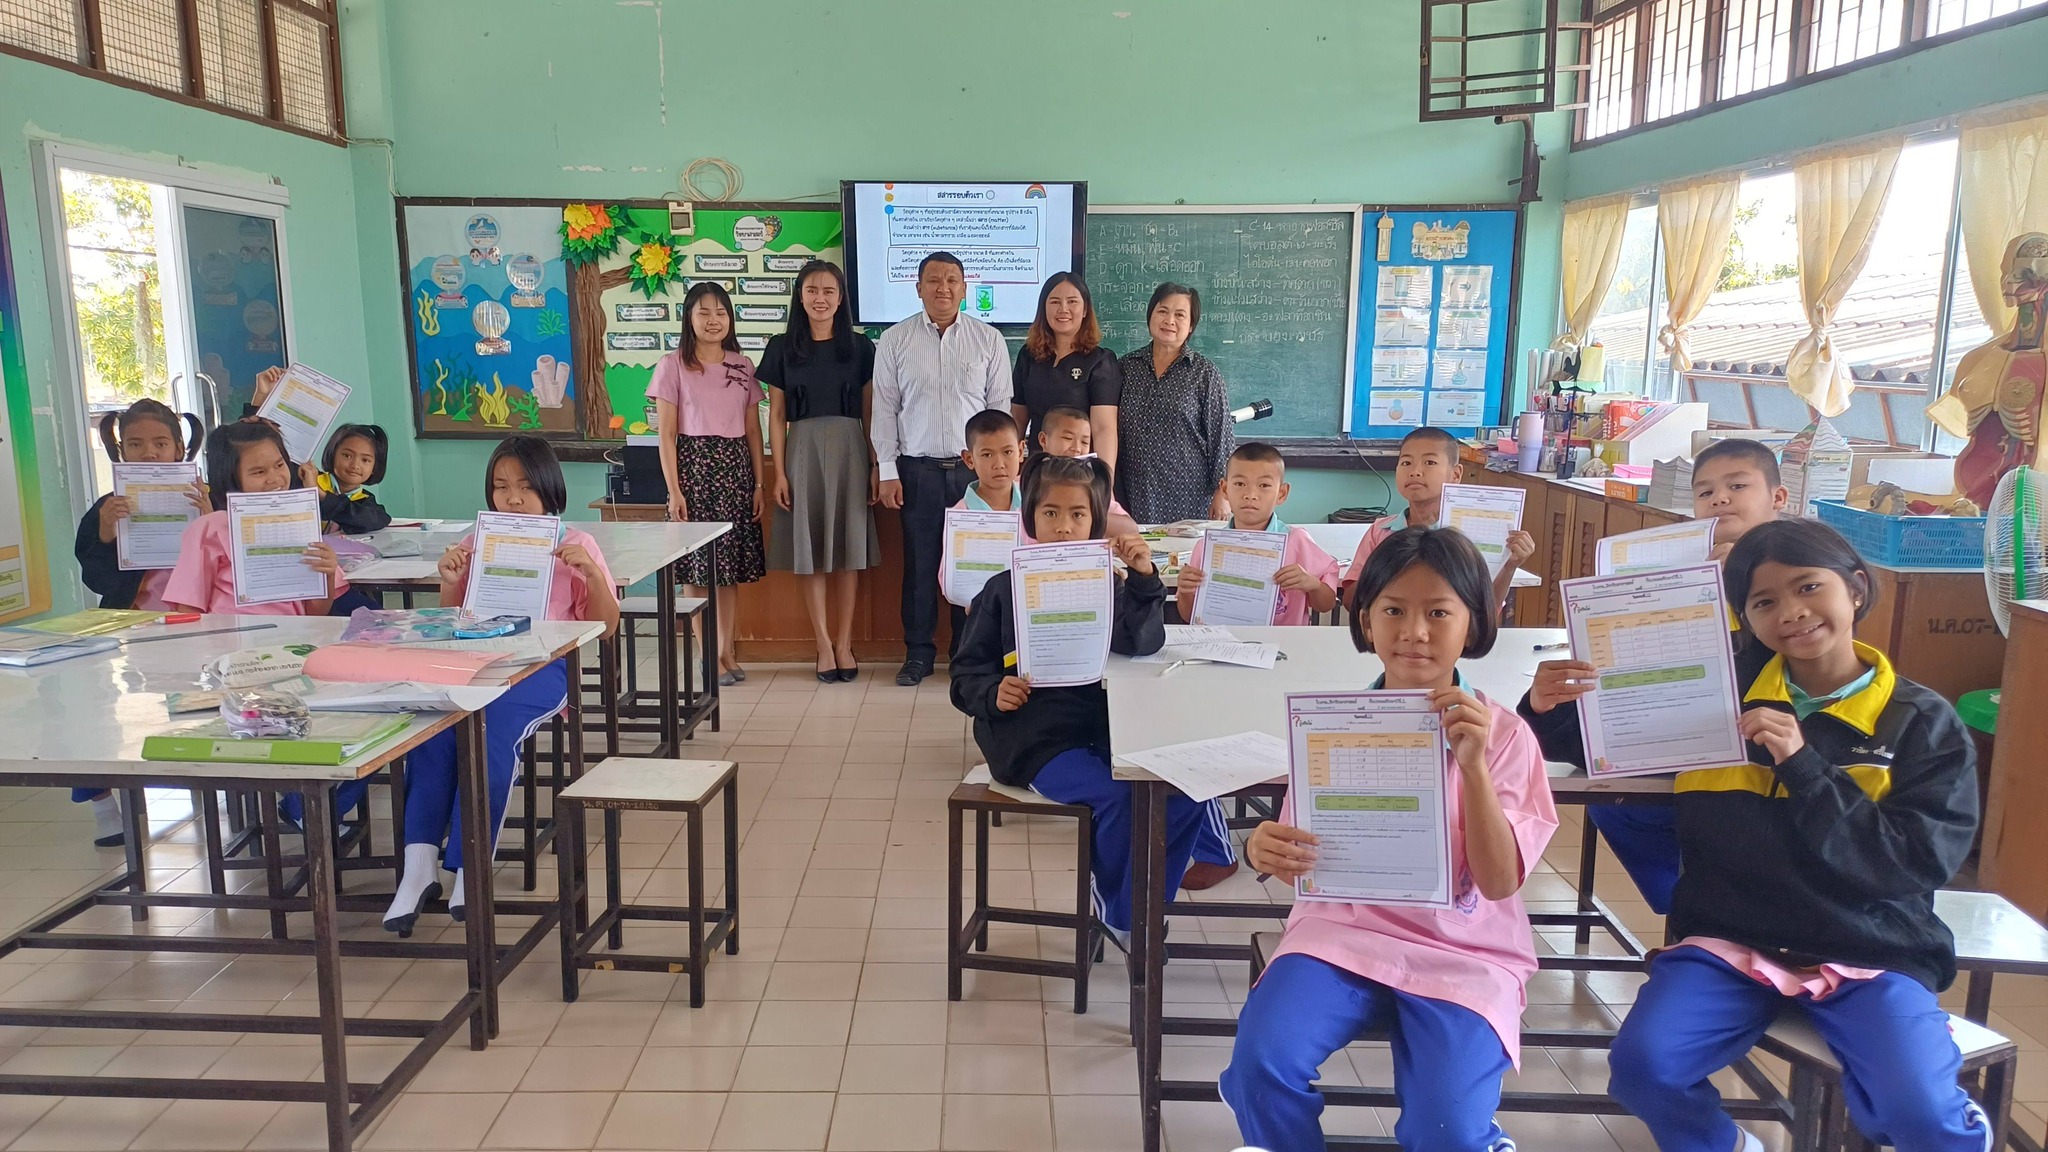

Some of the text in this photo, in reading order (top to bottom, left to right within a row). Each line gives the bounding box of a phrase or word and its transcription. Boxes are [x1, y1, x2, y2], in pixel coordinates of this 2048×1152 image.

[937, 191, 984, 199] สสารรอบตัวเรา
[1099, 224, 1107, 237] A
